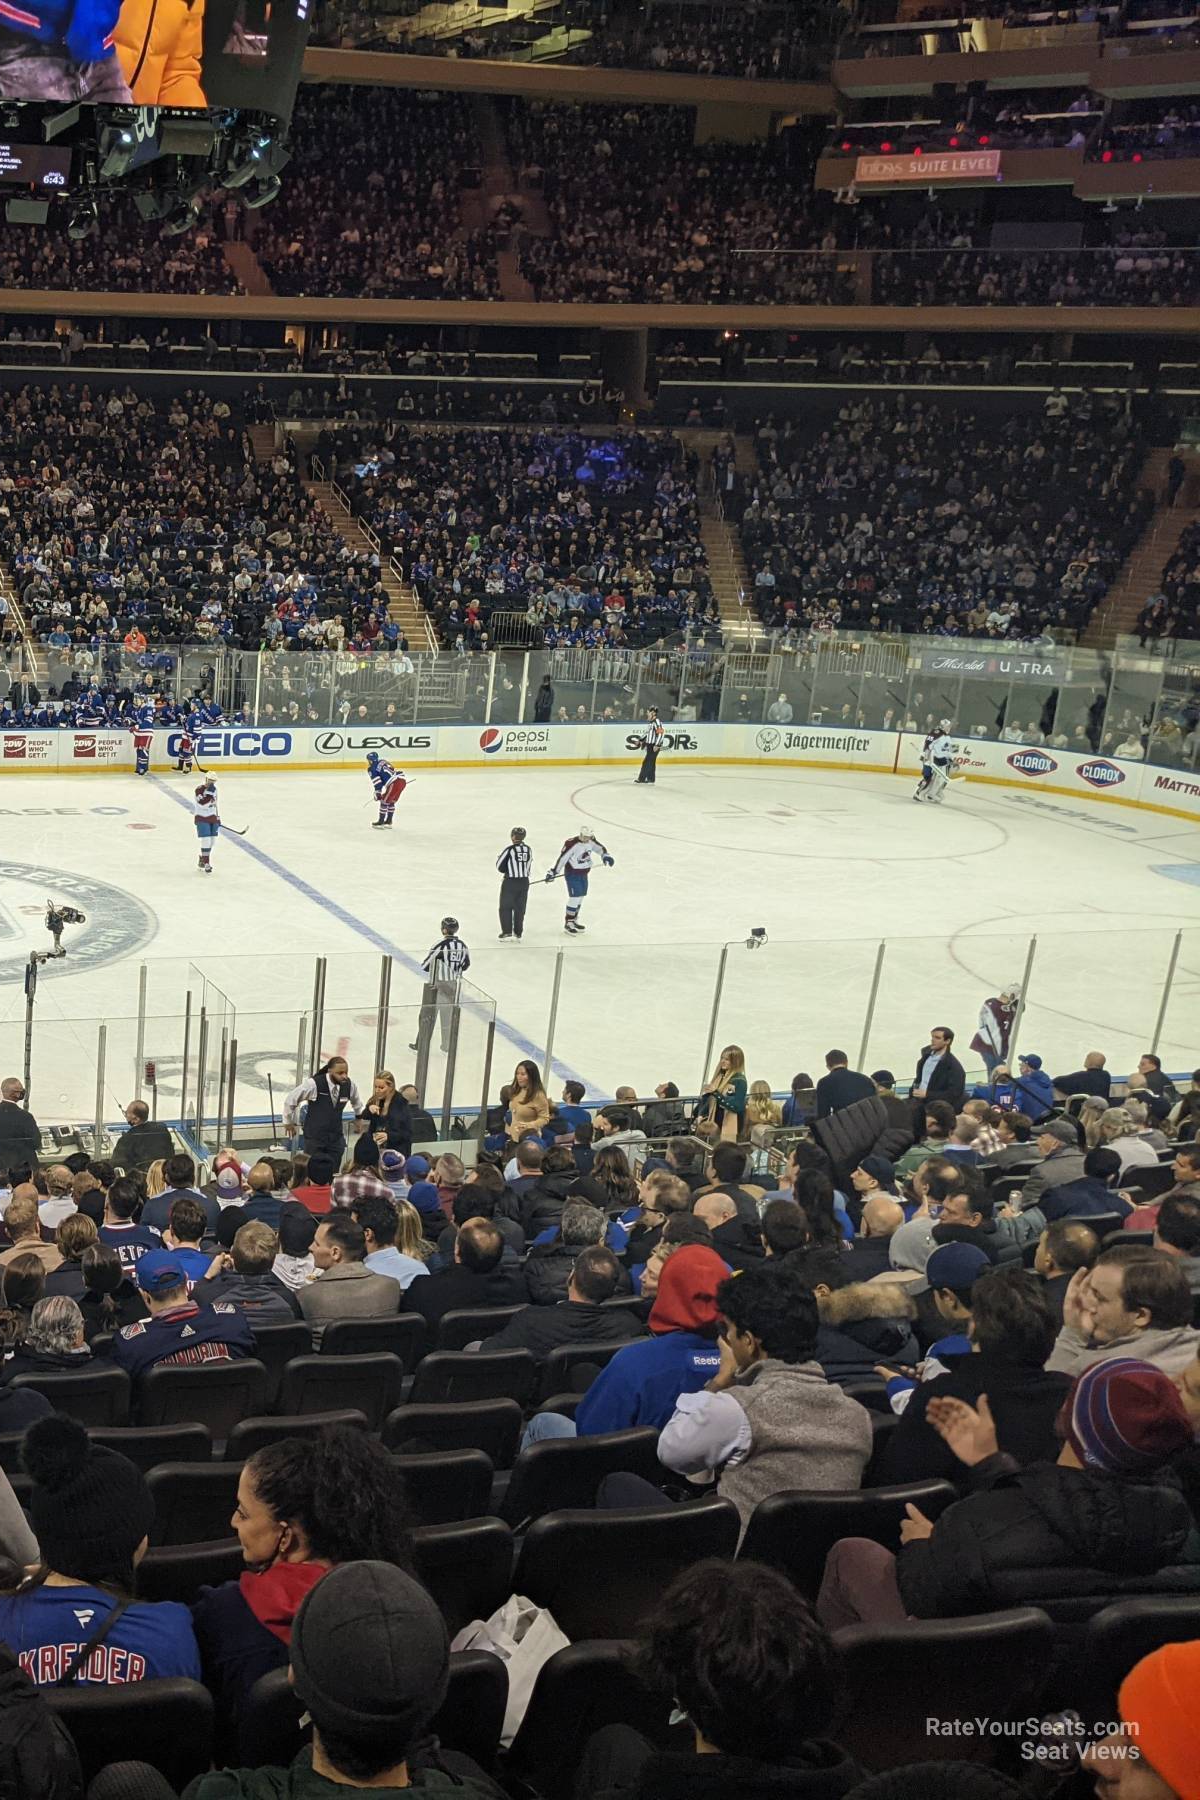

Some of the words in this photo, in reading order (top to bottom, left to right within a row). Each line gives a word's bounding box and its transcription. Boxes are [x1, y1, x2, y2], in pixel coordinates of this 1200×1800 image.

[909, 160, 948, 173] SUITE
[952, 158, 993, 172] LEVEL
[43, 176, 65, 185] 6:43
[347, 736, 431, 749] LEXUS
[506, 728, 550, 744] pepsi
[783, 732, 870, 752] Jägermeister
[1013, 755, 1052, 772] CLOROX
[1082, 765, 1121, 782] CLOROX
[1154, 775, 1200, 797] MATTR
